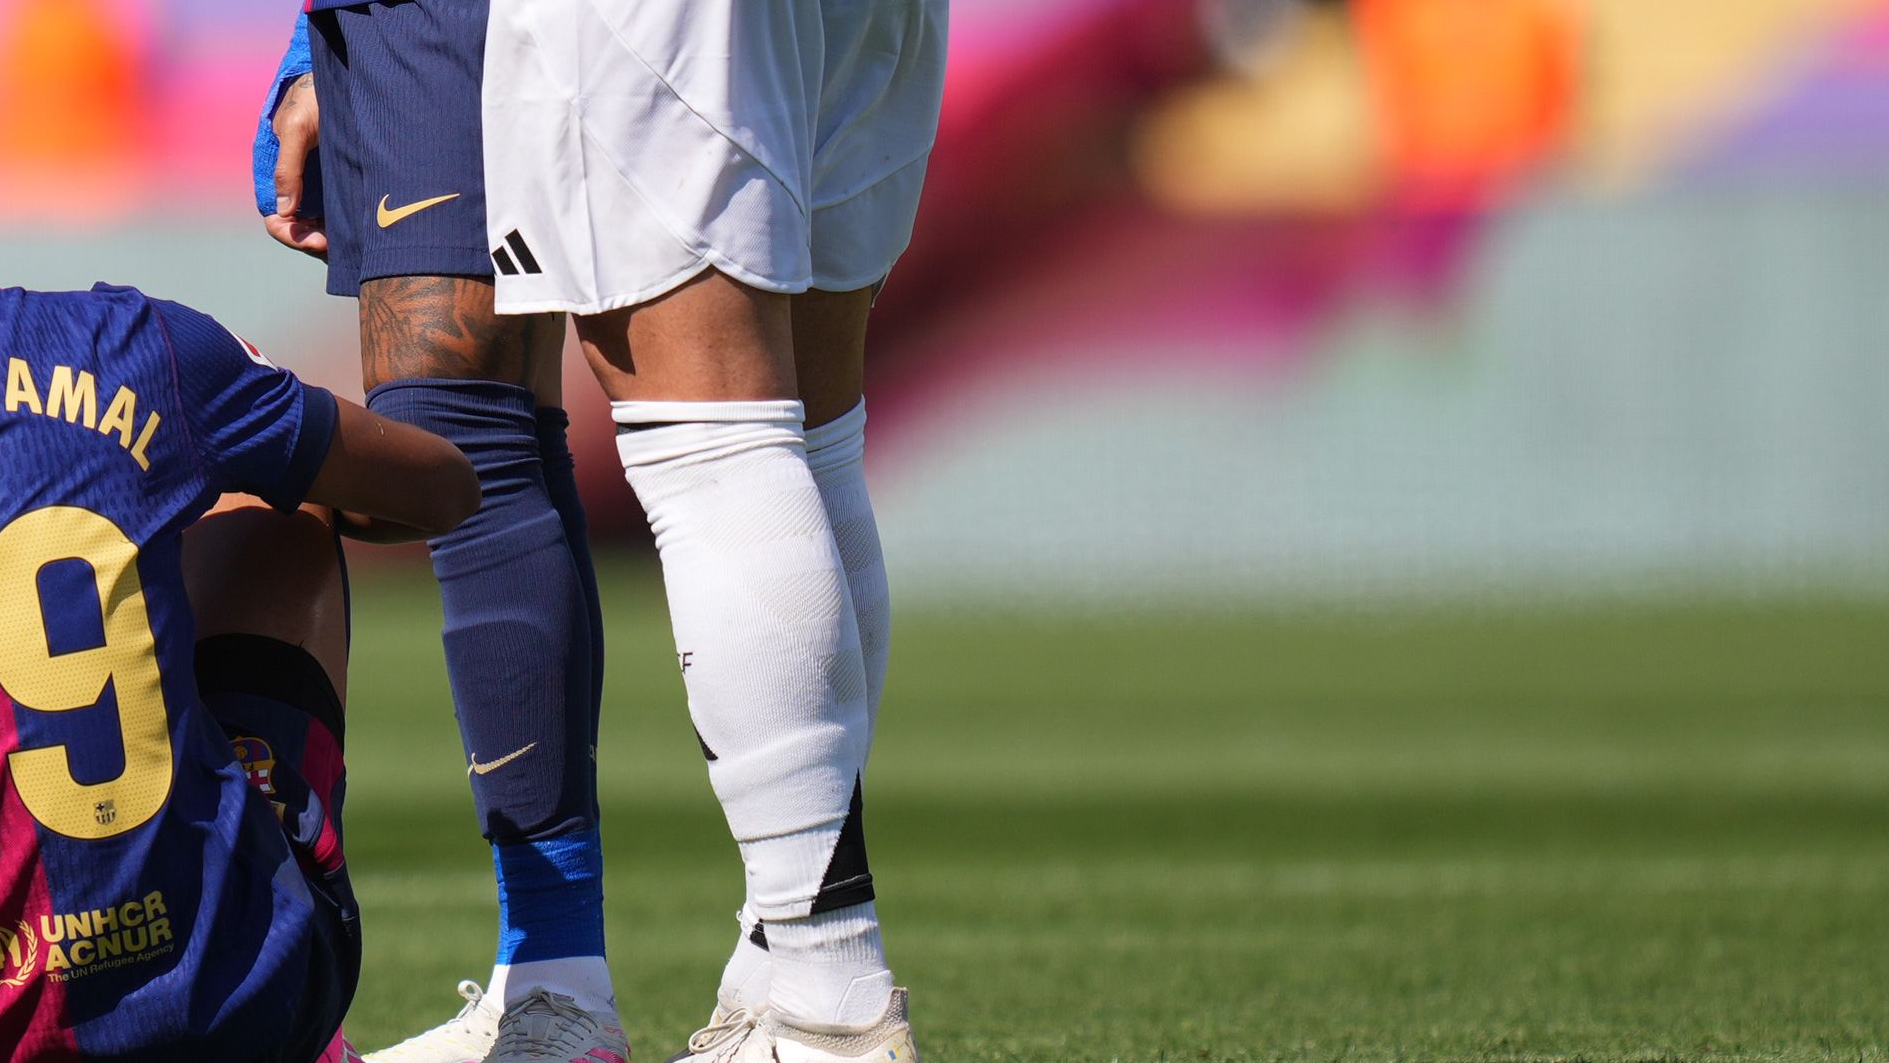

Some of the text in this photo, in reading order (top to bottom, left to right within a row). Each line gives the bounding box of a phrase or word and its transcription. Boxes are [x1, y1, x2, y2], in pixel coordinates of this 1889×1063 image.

[40, 889, 168, 943] UNHCR
[45, 918, 174, 972] ACNUR
[47, 943, 176, 984] The UN Refugee Agency
